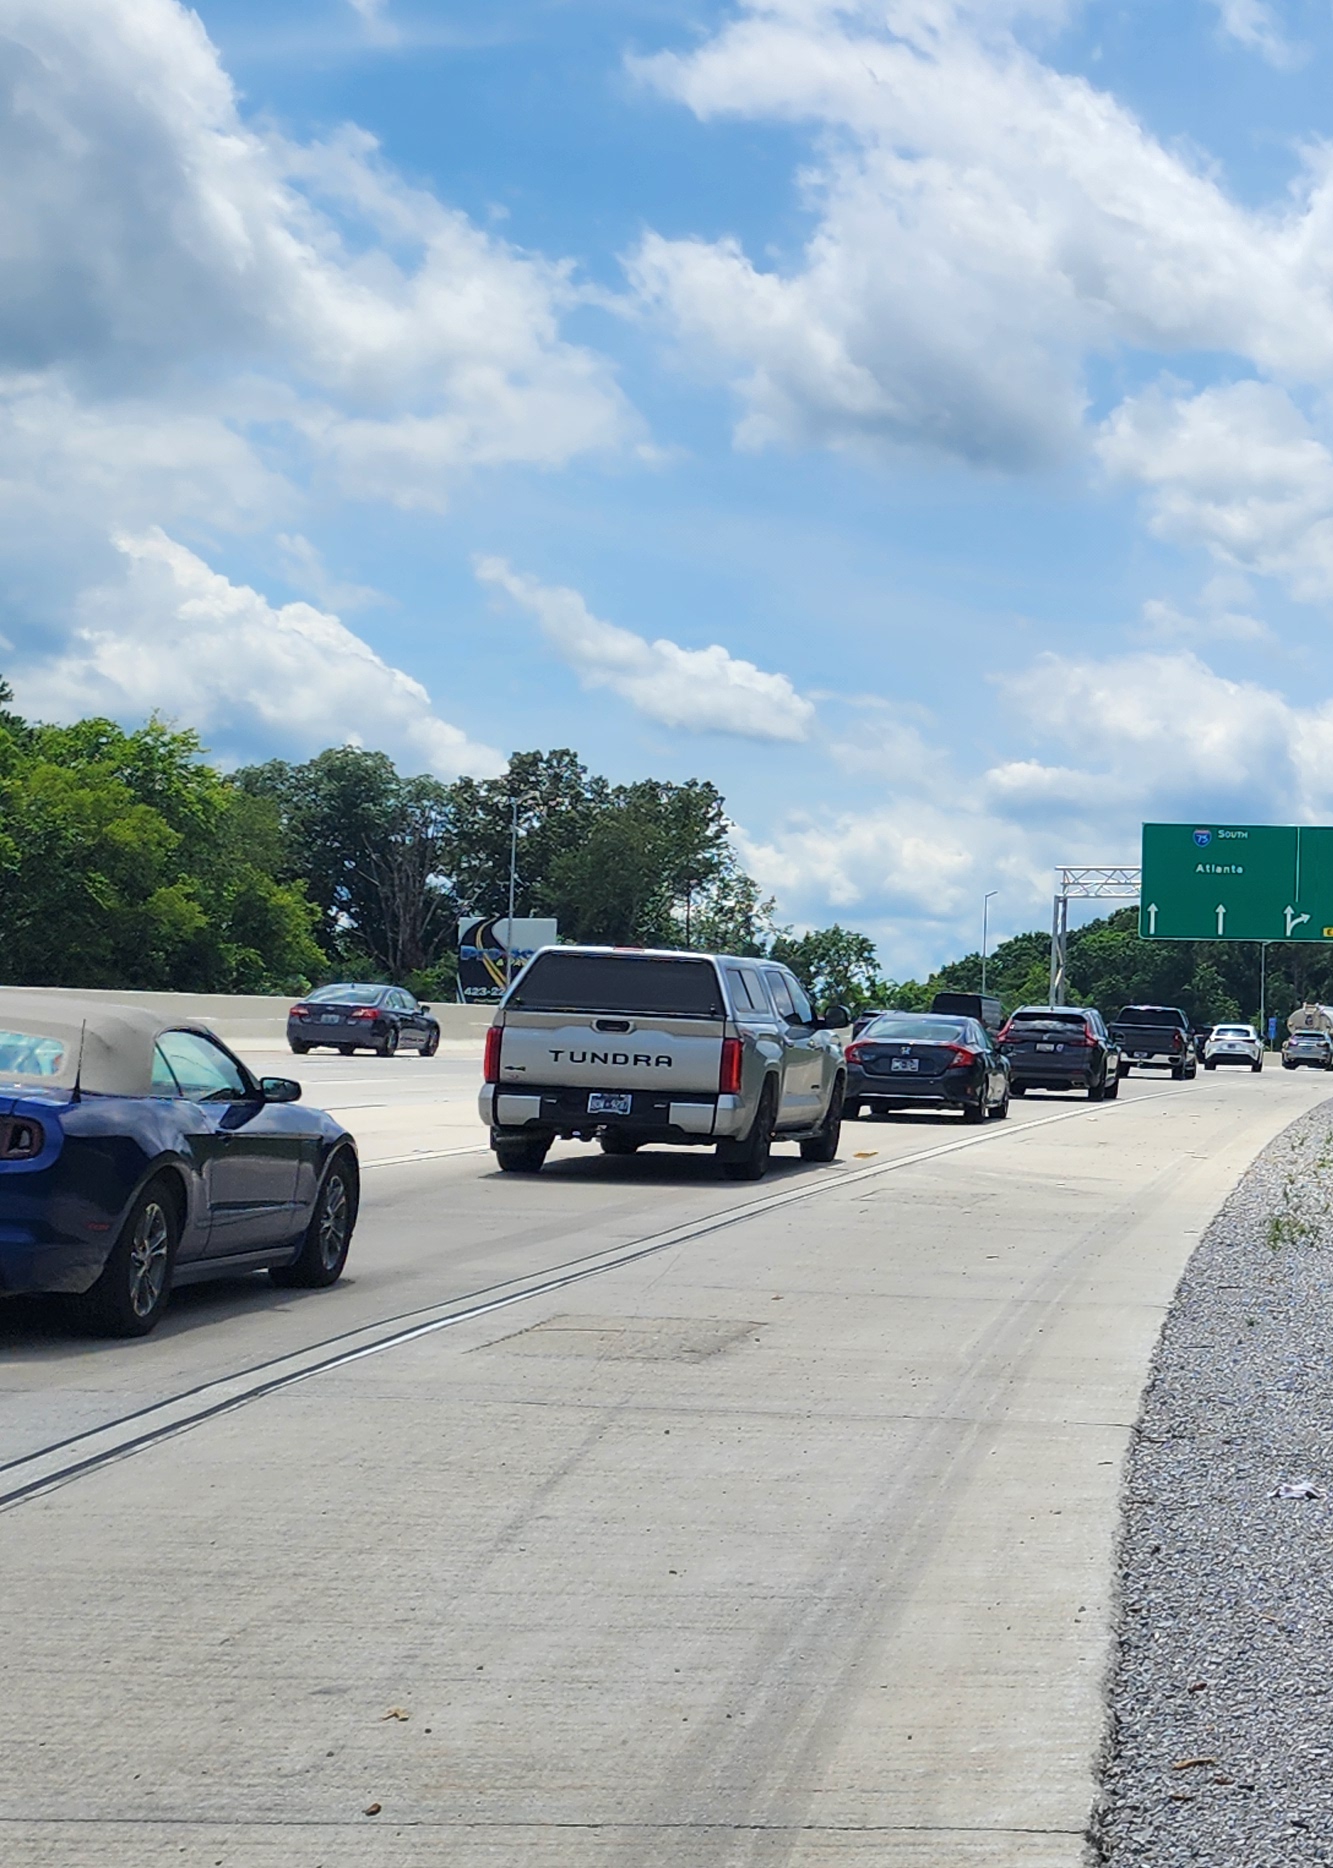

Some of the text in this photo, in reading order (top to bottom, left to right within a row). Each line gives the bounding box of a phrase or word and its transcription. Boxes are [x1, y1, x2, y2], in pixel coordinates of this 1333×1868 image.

[1196, 829, 1249, 844] 75 SOUTH
[1195, 864, 1244, 874] Atlanta
[549, 1049, 673, 1068] TUNDRA
